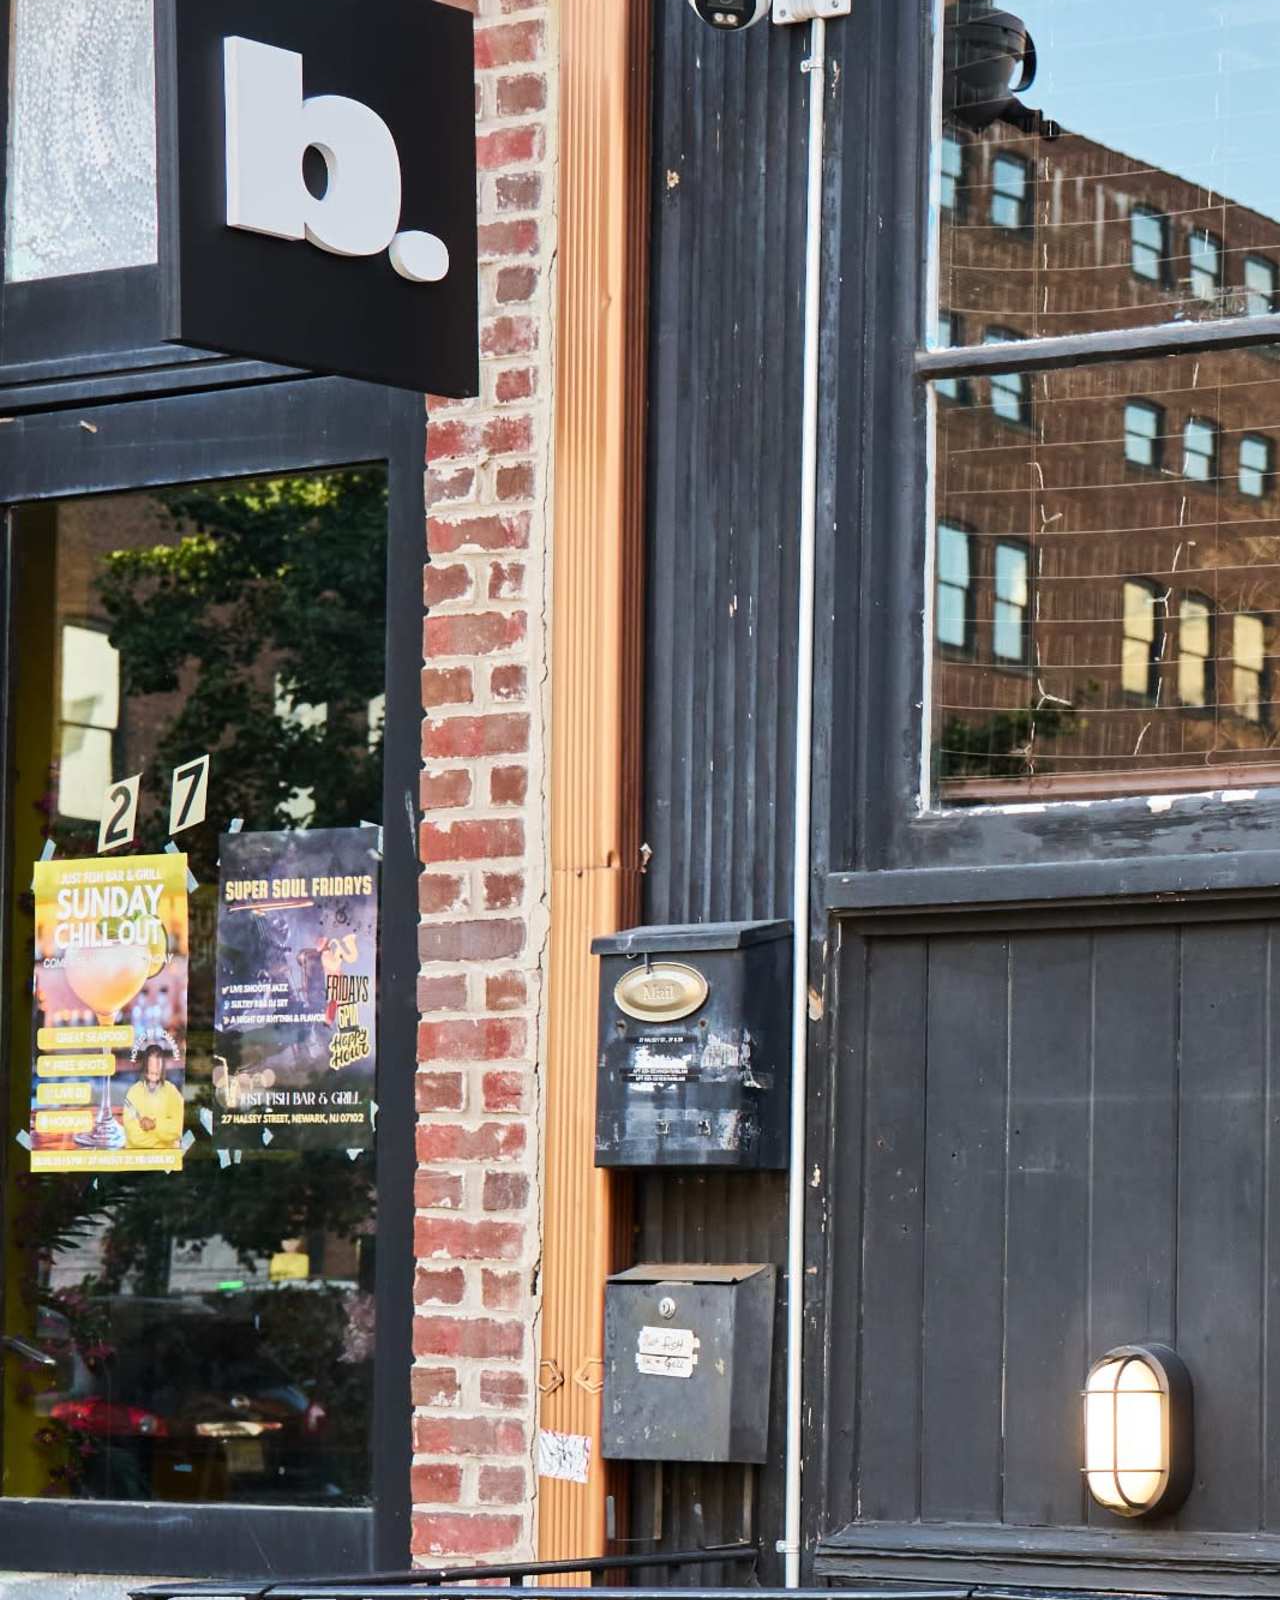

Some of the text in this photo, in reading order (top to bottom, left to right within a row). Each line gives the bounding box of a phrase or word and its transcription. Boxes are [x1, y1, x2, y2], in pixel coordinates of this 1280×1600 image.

[224, 35, 449, 282] b.
[225, 875, 372, 901] SUPER SOUL FRIDAYS
[57, 884, 164, 920] SUNDAY
[54, 918, 162, 949] CHILL OUT
[327, 975, 369, 1002] FRIDAYS
[338, 1005, 359, 1028] 6PM
[266, 1091, 290, 1105] FISH
[293, 1091, 316, 1105] BAR
[318, 1091, 328, 1104] &
[331, 1090, 362, 1104] GRILL
[221, 1113, 364, 1125] 27 HALSEY STREET, NEWARK, NJ 07102
